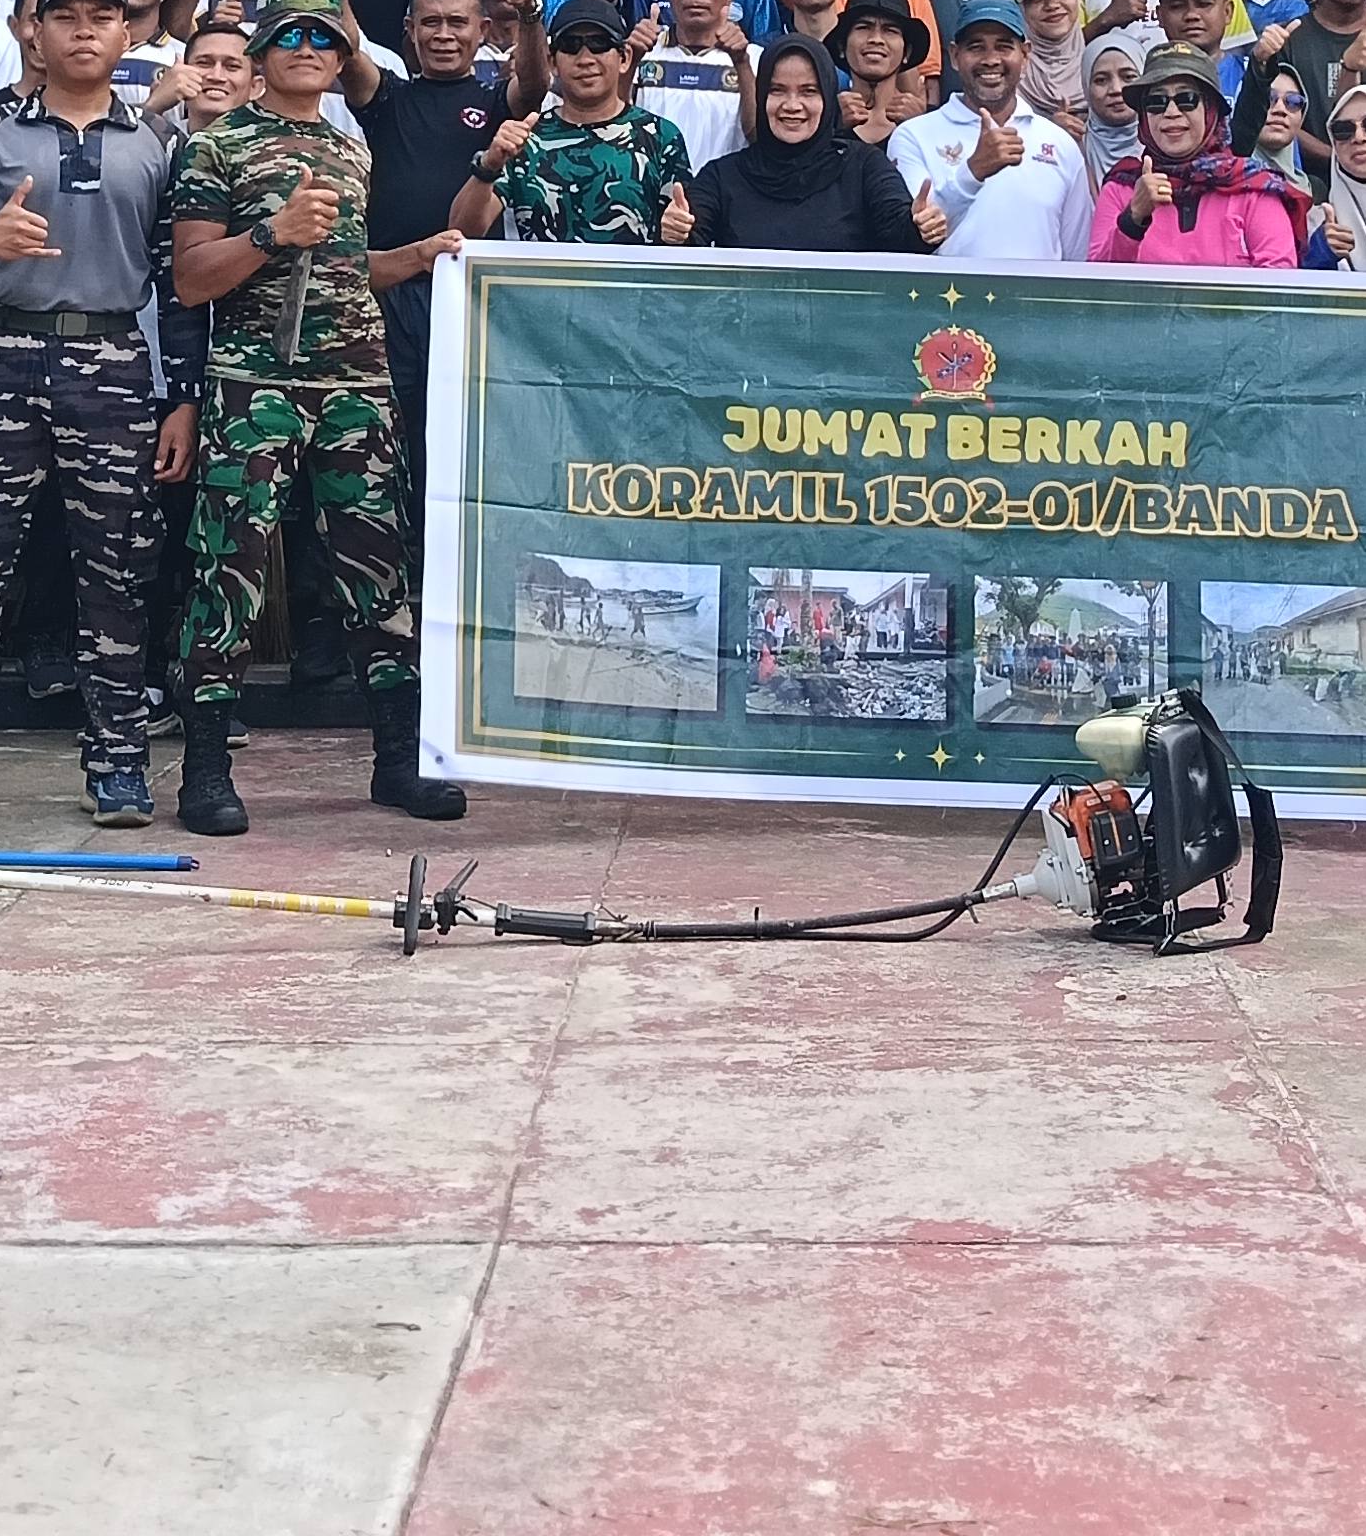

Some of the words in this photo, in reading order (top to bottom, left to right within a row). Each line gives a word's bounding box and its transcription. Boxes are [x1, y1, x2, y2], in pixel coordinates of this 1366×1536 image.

[722, 405, 936, 459] JUM'AT
[946, 413, 1188, 468] BERKAH
[567, 462, 858, 524] KORAMIL
[863, 474, 1359, 542] 1502-01/BANDA
